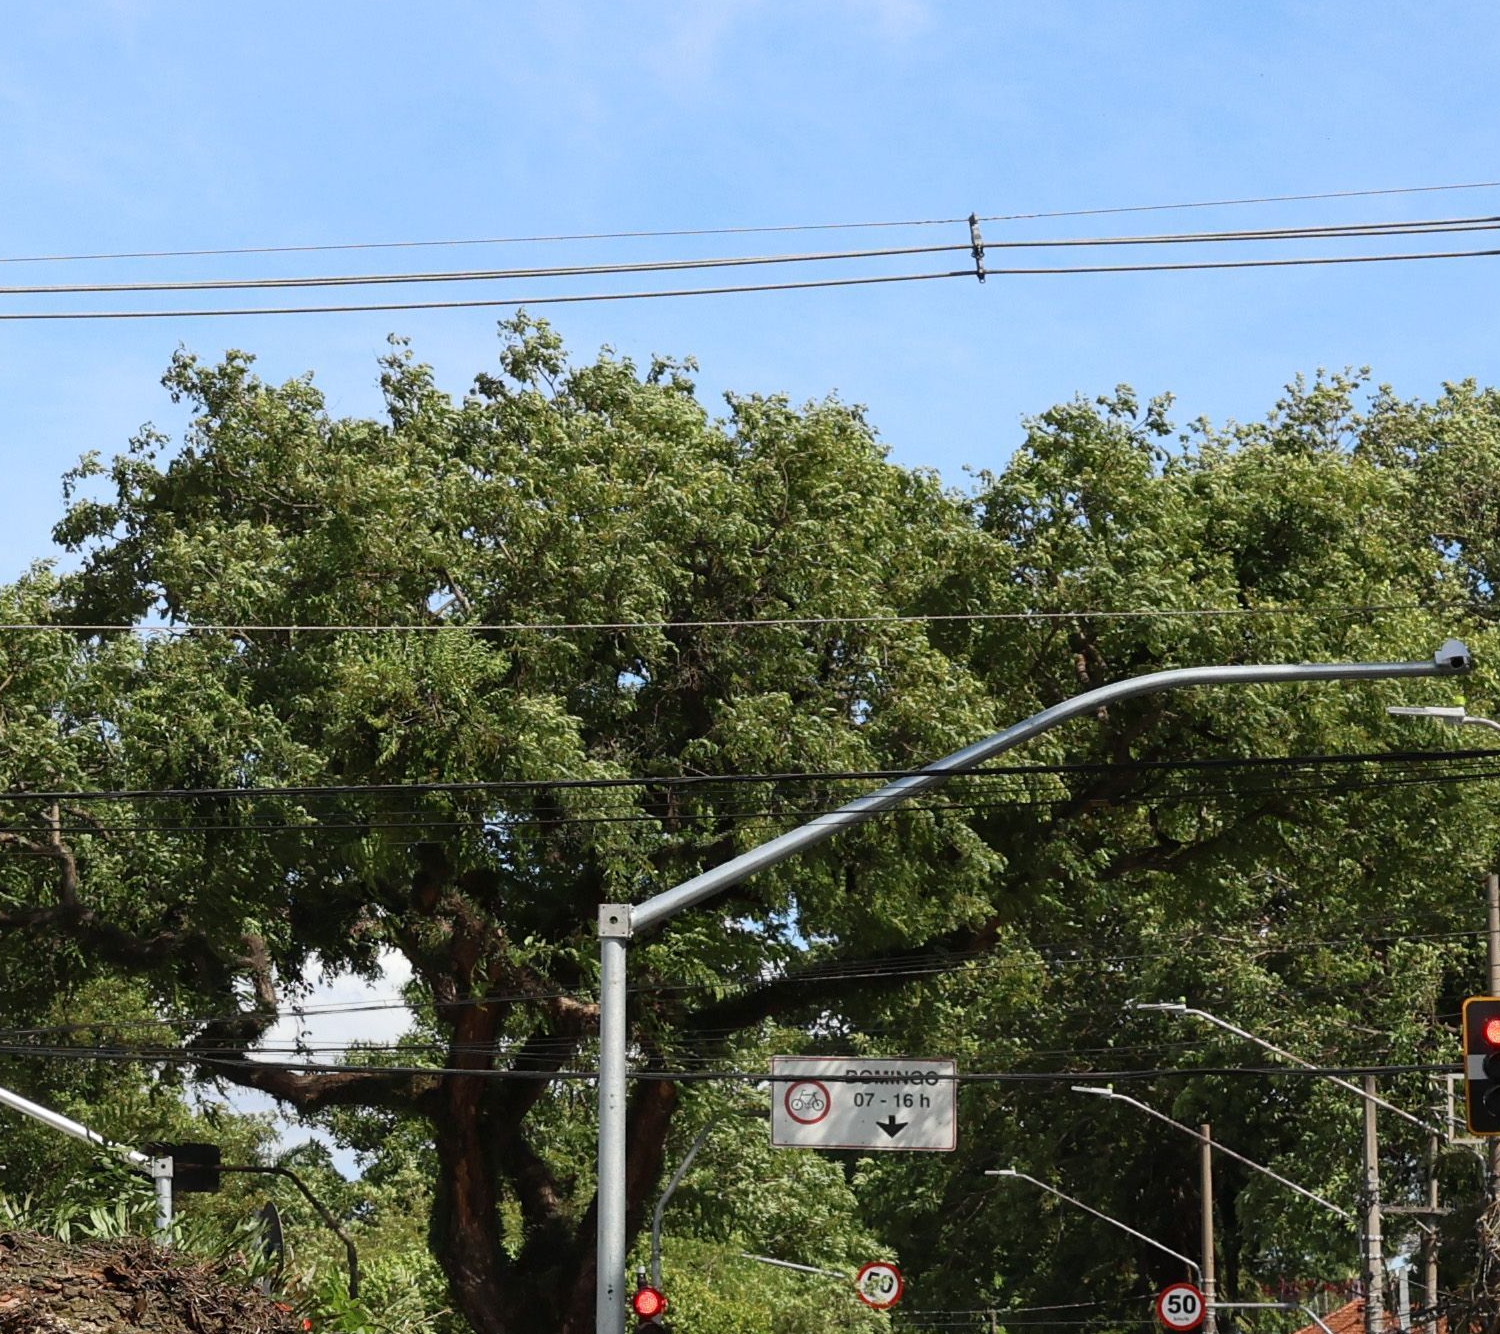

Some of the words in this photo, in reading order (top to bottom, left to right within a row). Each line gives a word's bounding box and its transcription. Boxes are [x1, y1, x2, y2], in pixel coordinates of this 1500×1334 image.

[845, 1069, 939, 1087] DOMINGO
[853, 1093, 874, 1108] 07
[893, 1093, 914, 1108] 16
[919, 1094, 931, 1108] h
[1167, 1294, 1197, 1315] 50
